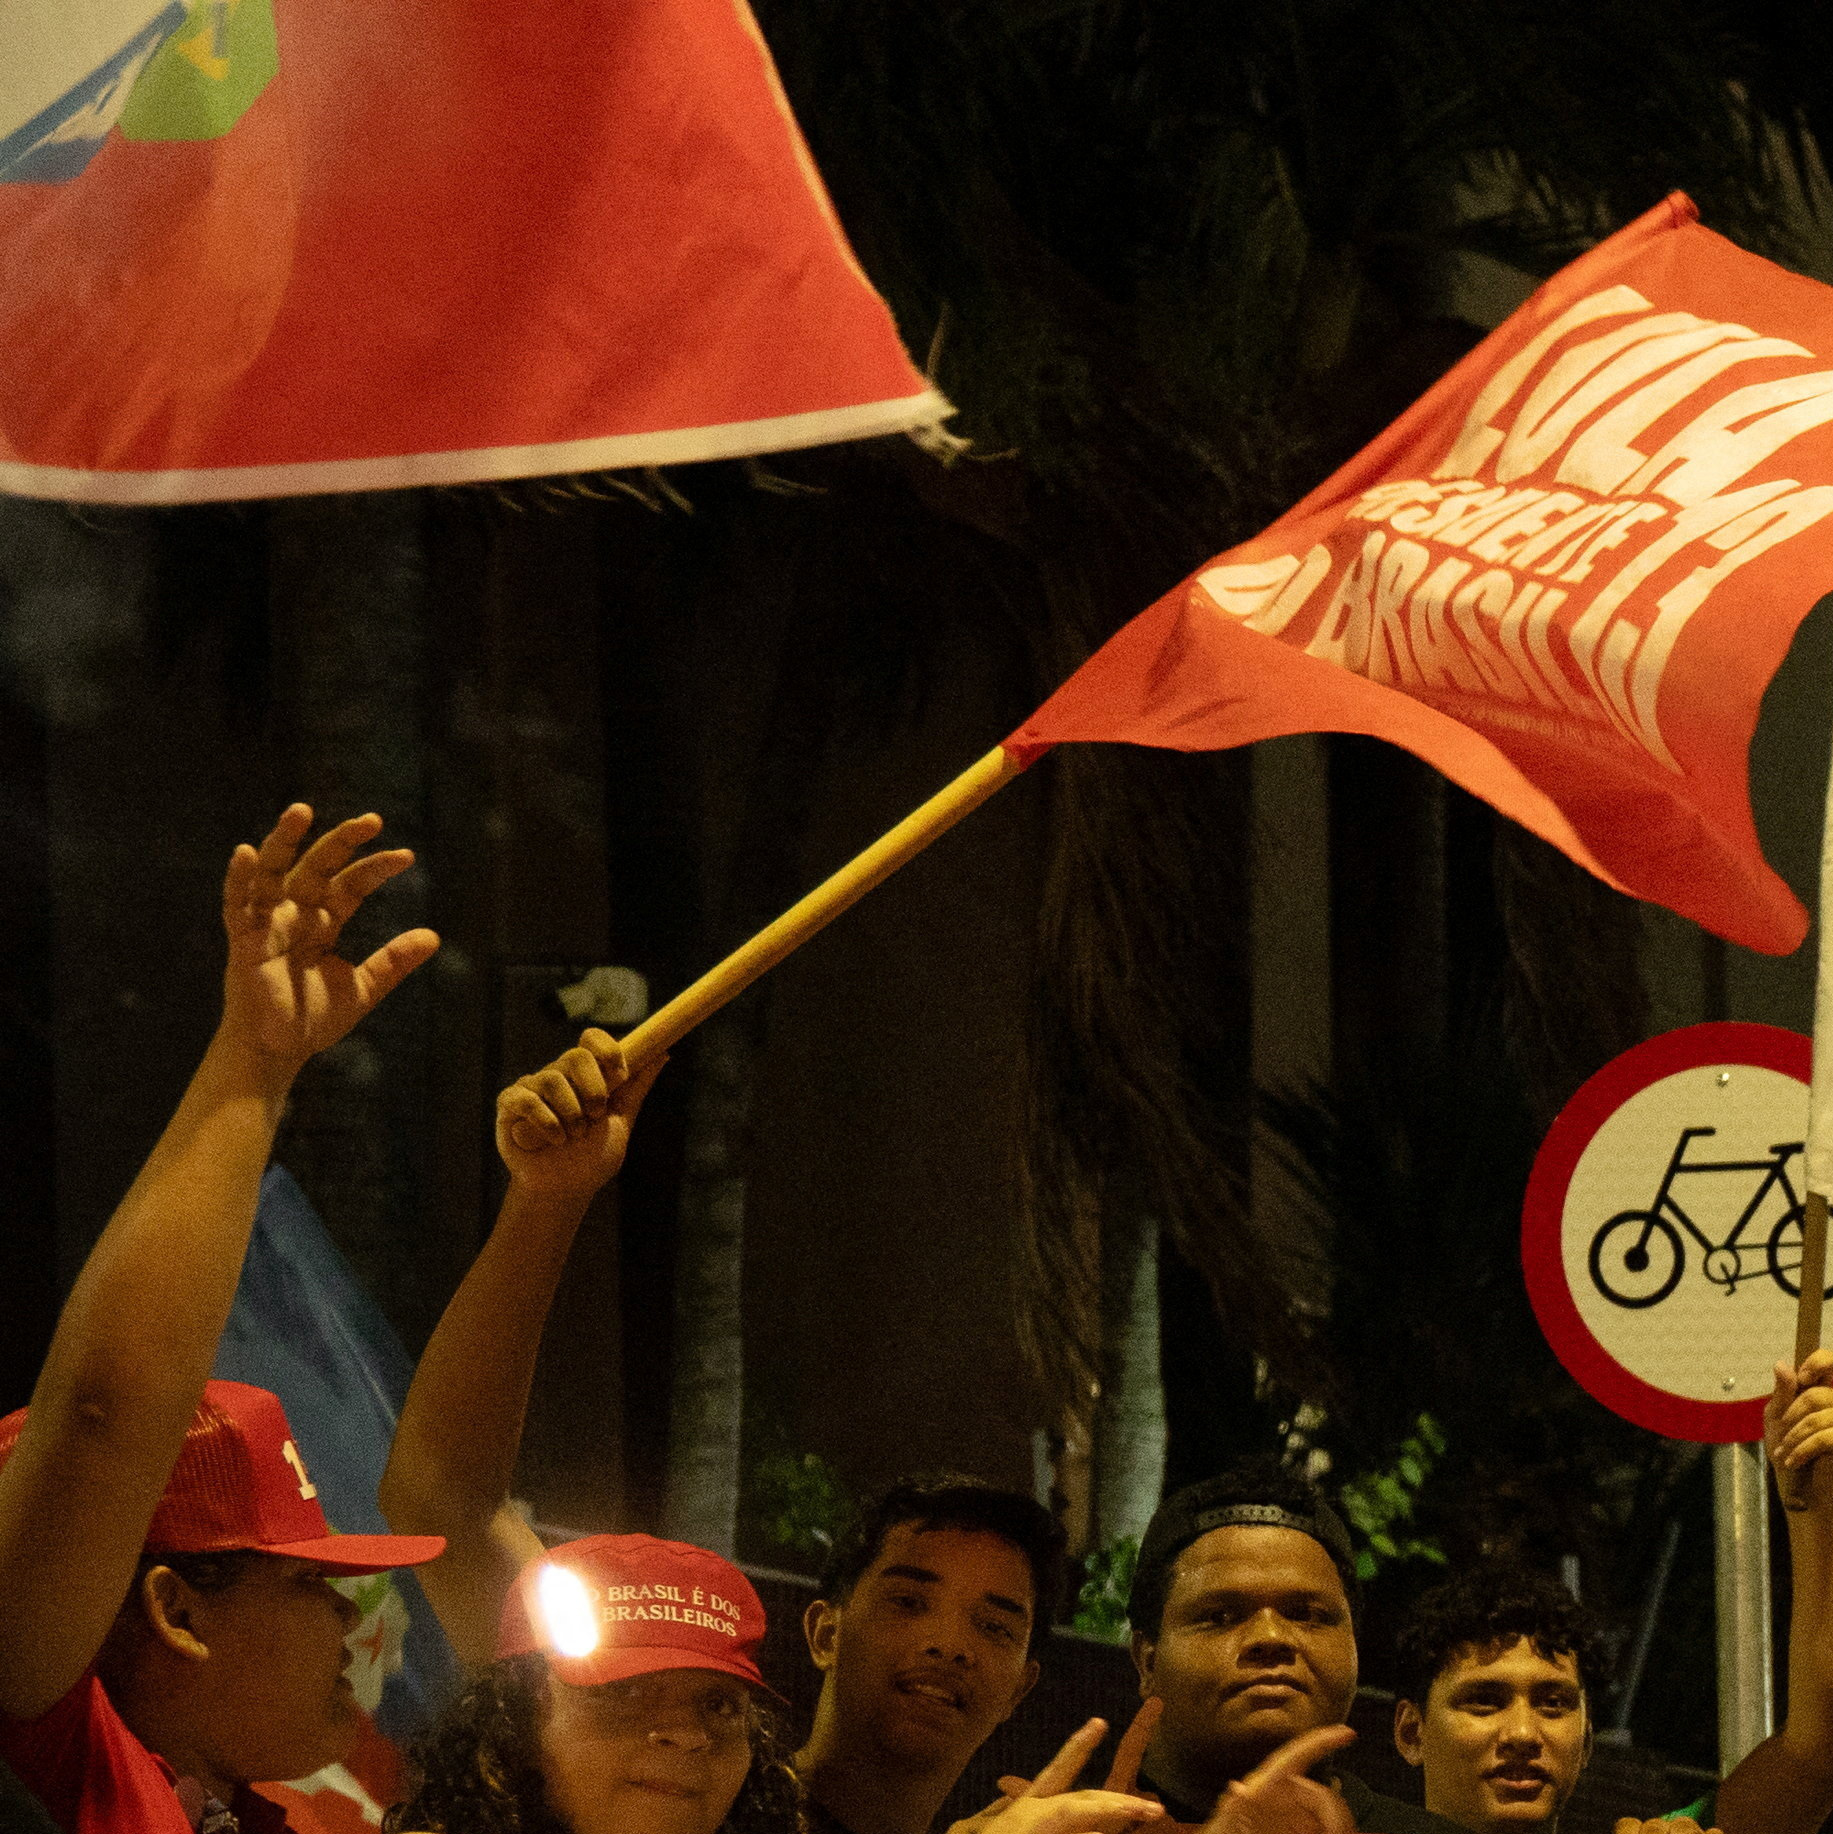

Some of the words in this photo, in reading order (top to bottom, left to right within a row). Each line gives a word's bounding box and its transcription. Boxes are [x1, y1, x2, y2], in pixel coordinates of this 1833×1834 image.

[1303, 530, 1608, 722] BRASIL
[600, 1604, 738, 1637] BRASILEIROS
[608, 1584, 686, 1604] BRASIL
[692, 1586, 705, 1606] É
[711, 1593, 741, 1621] DOS
